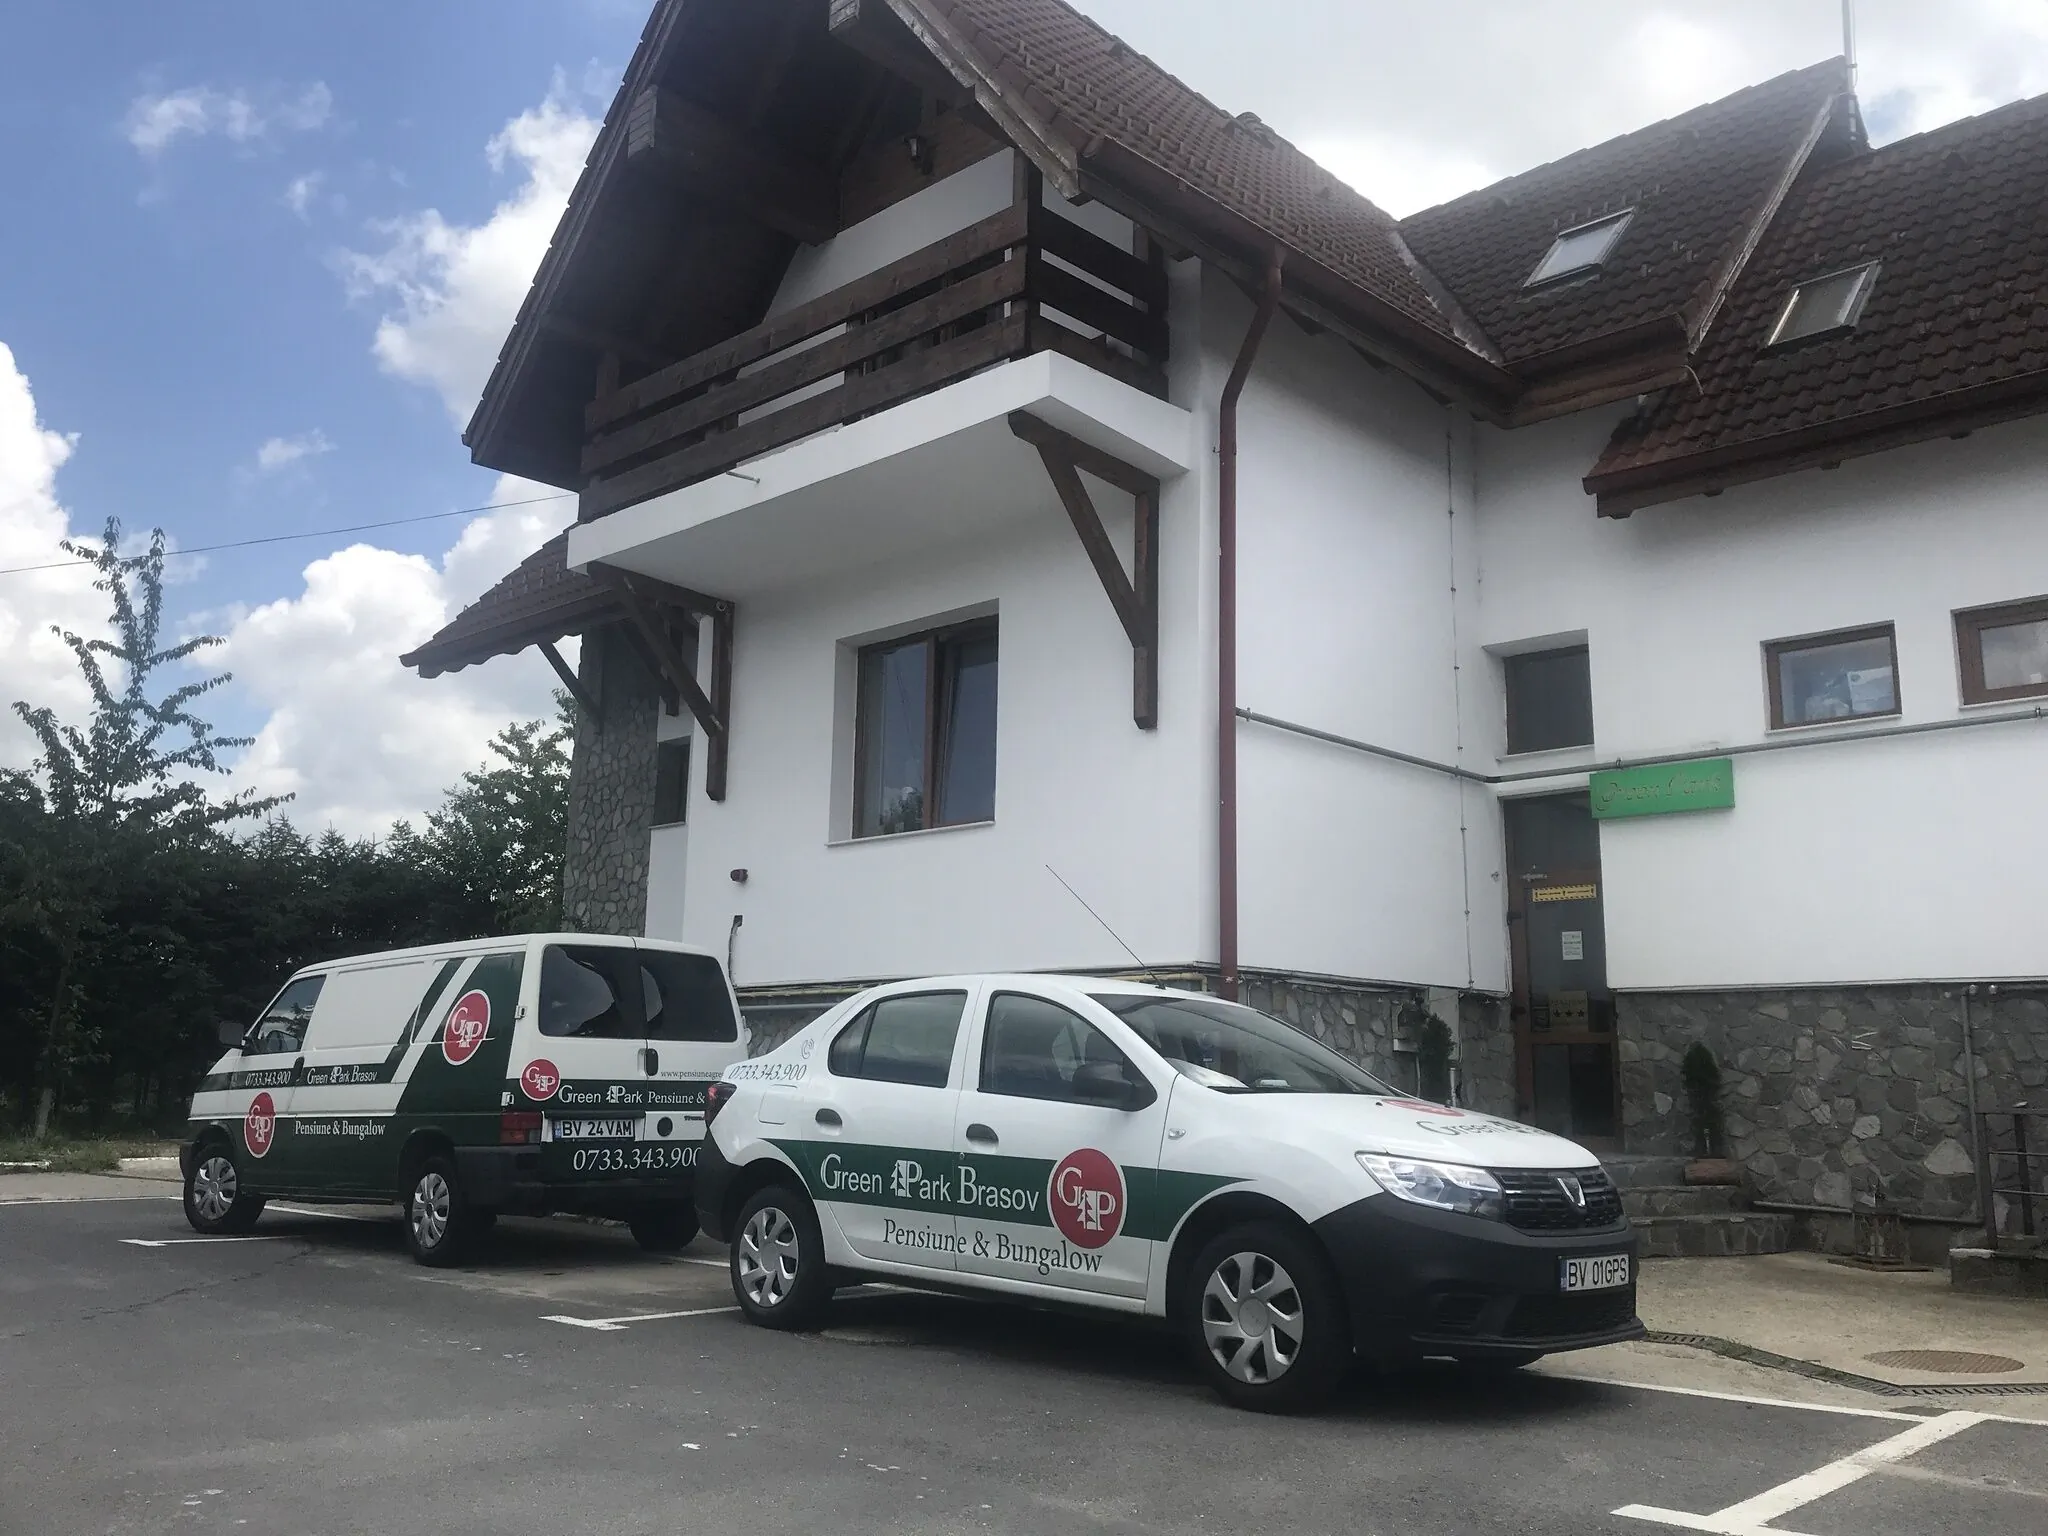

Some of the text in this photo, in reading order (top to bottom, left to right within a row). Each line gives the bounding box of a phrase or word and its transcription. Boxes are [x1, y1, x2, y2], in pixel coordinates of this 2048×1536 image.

[245, 1071, 291, 1087] 0733.343.900
[307, 1065, 378, 1085] Green Park Brasov
[728, 1064, 807, 1080] 0733.343.900
[558, 1085, 706, 1104] Green Park Pensiune &
[295, 1120, 386, 1140] Pensiune & Bungalow
[562, 1121, 632, 1136] BV 24 VAM
[820, 1153, 1040, 1212] Green Park Brasov
[883, 1218, 1103, 1276] Pensiune & Bungalow
[1569, 1261, 1587, 1288] BV
